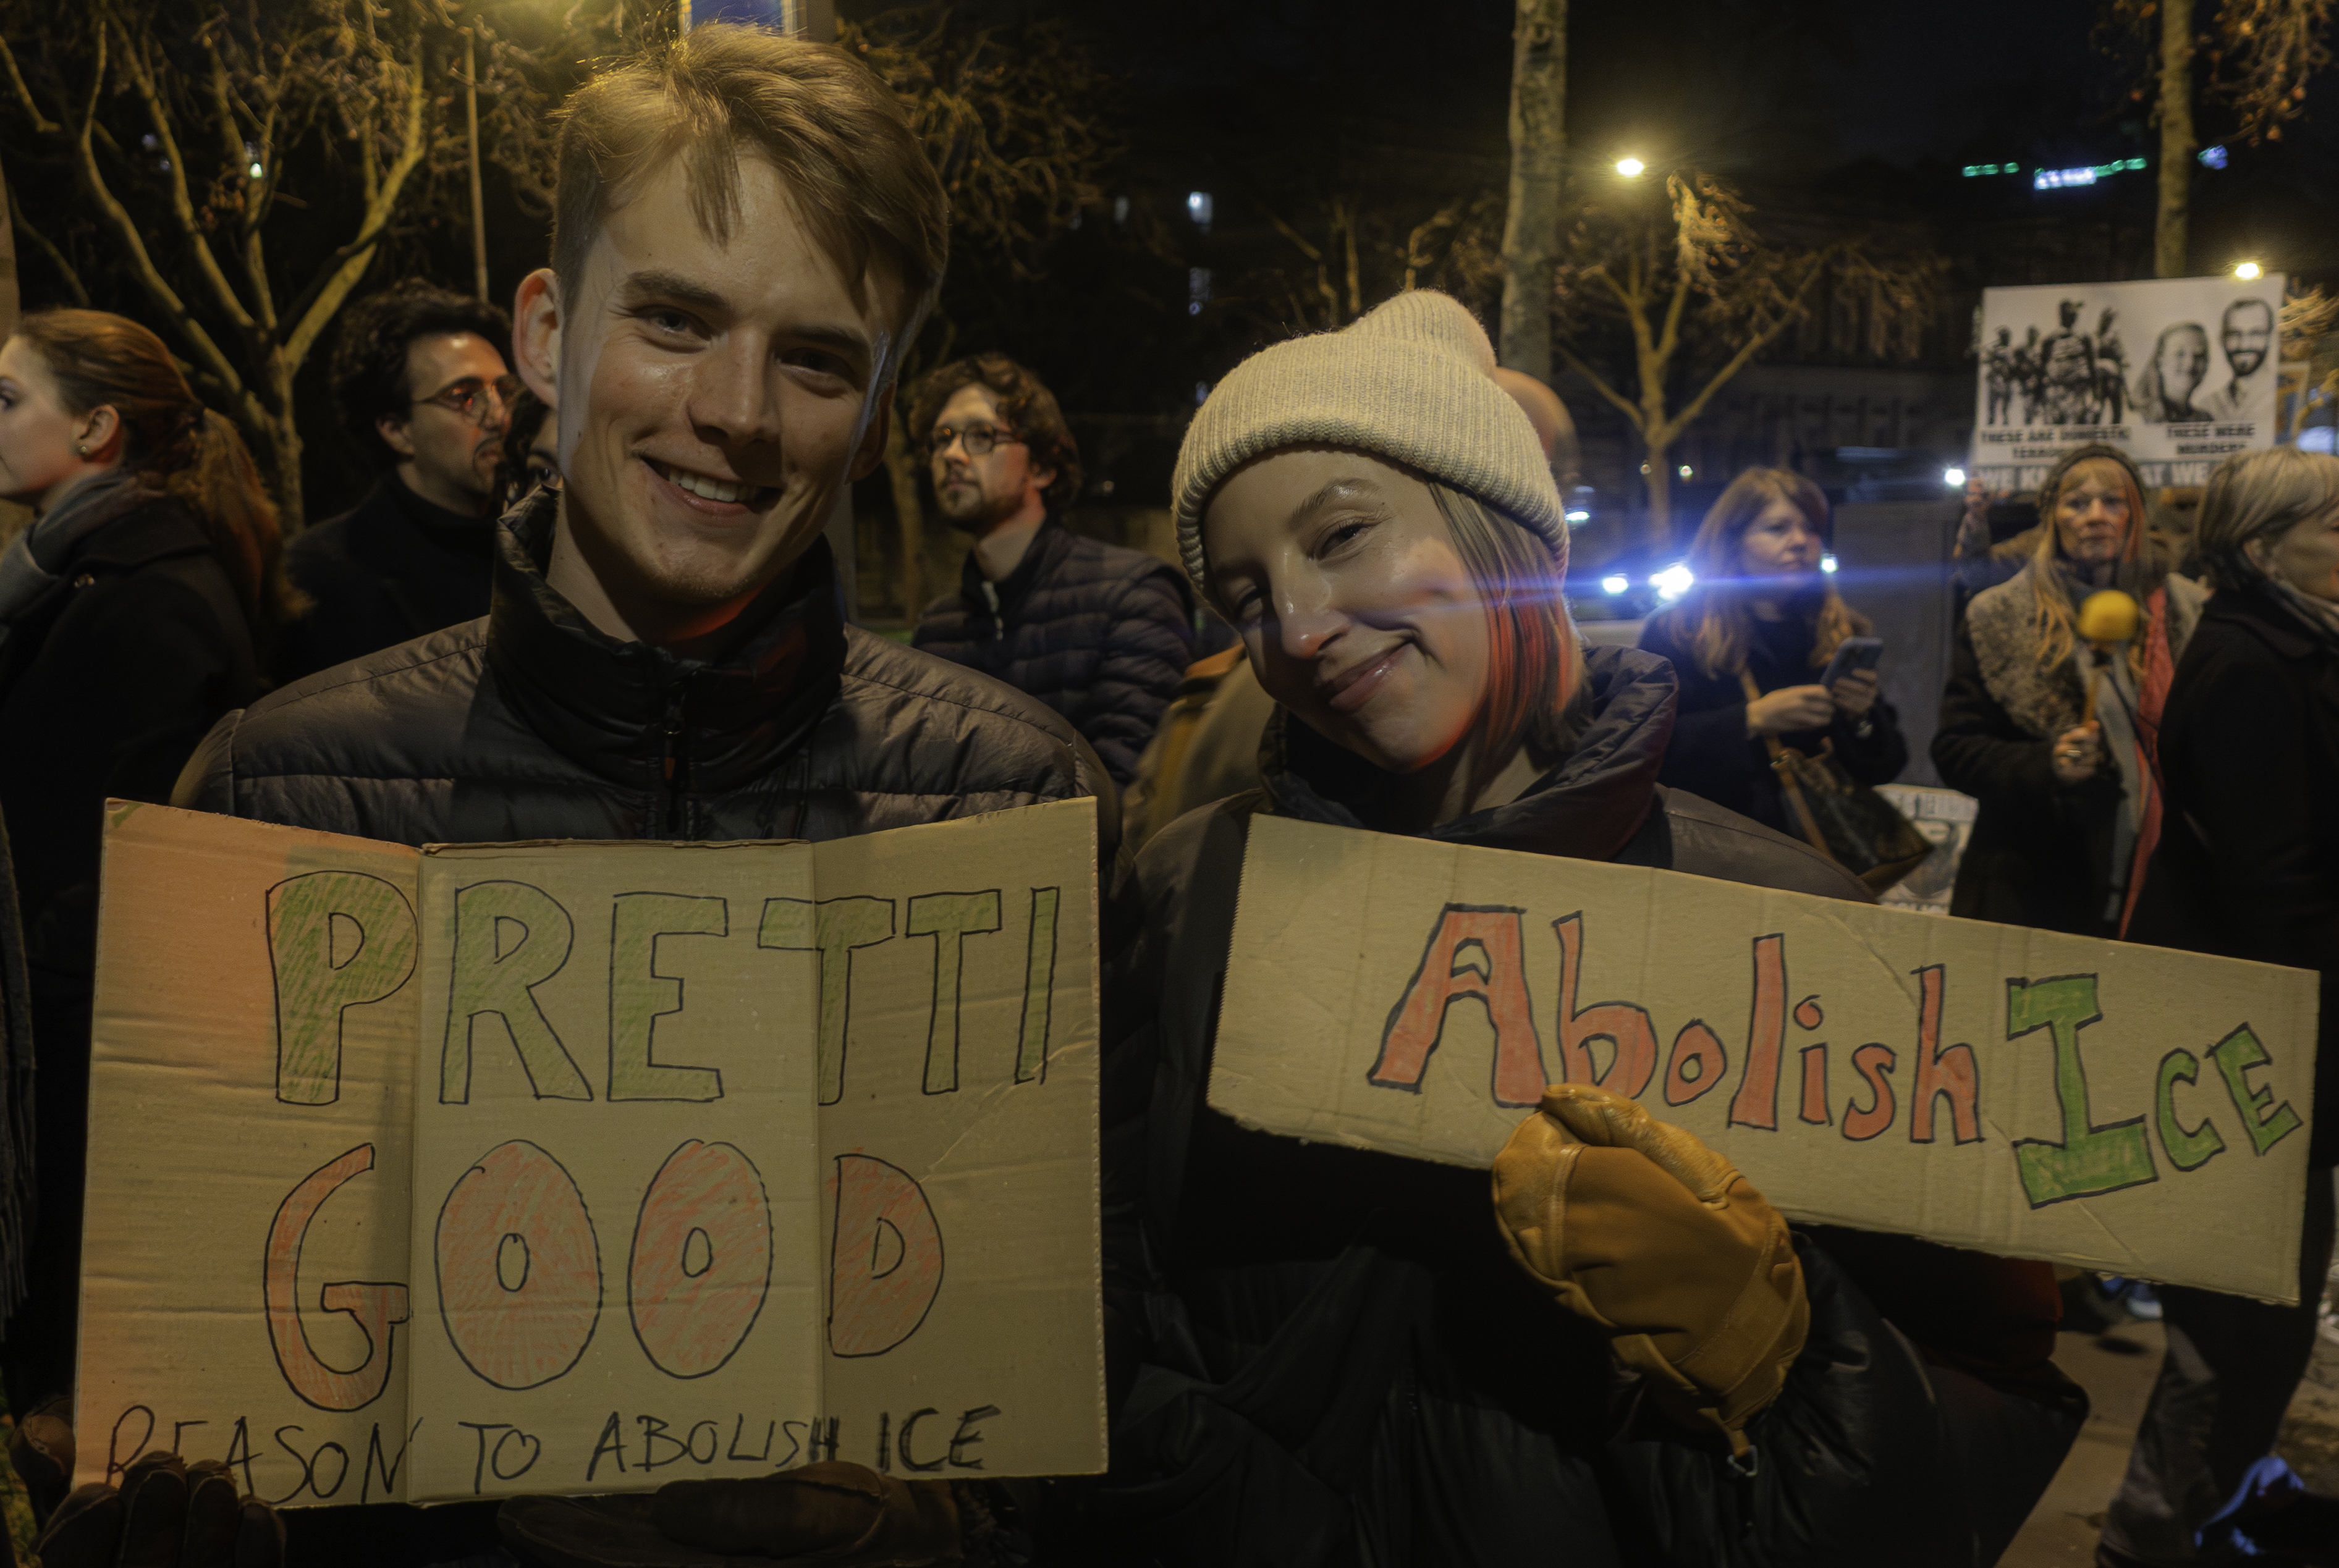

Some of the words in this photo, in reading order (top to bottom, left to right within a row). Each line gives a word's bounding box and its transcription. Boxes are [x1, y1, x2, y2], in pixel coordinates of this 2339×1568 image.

[266, 870, 1060, 1106] PRETTI
[1367, 901, 1986, 1146] Abolish
[2006, 972, 2304, 1210] ICE
[264, 1139, 945, 1412] GOOD
[458, 1420, 540, 1494] TO
[586, 1411, 840, 1481] ABOLISH
[877, 1404, 1002, 1475] ICE
